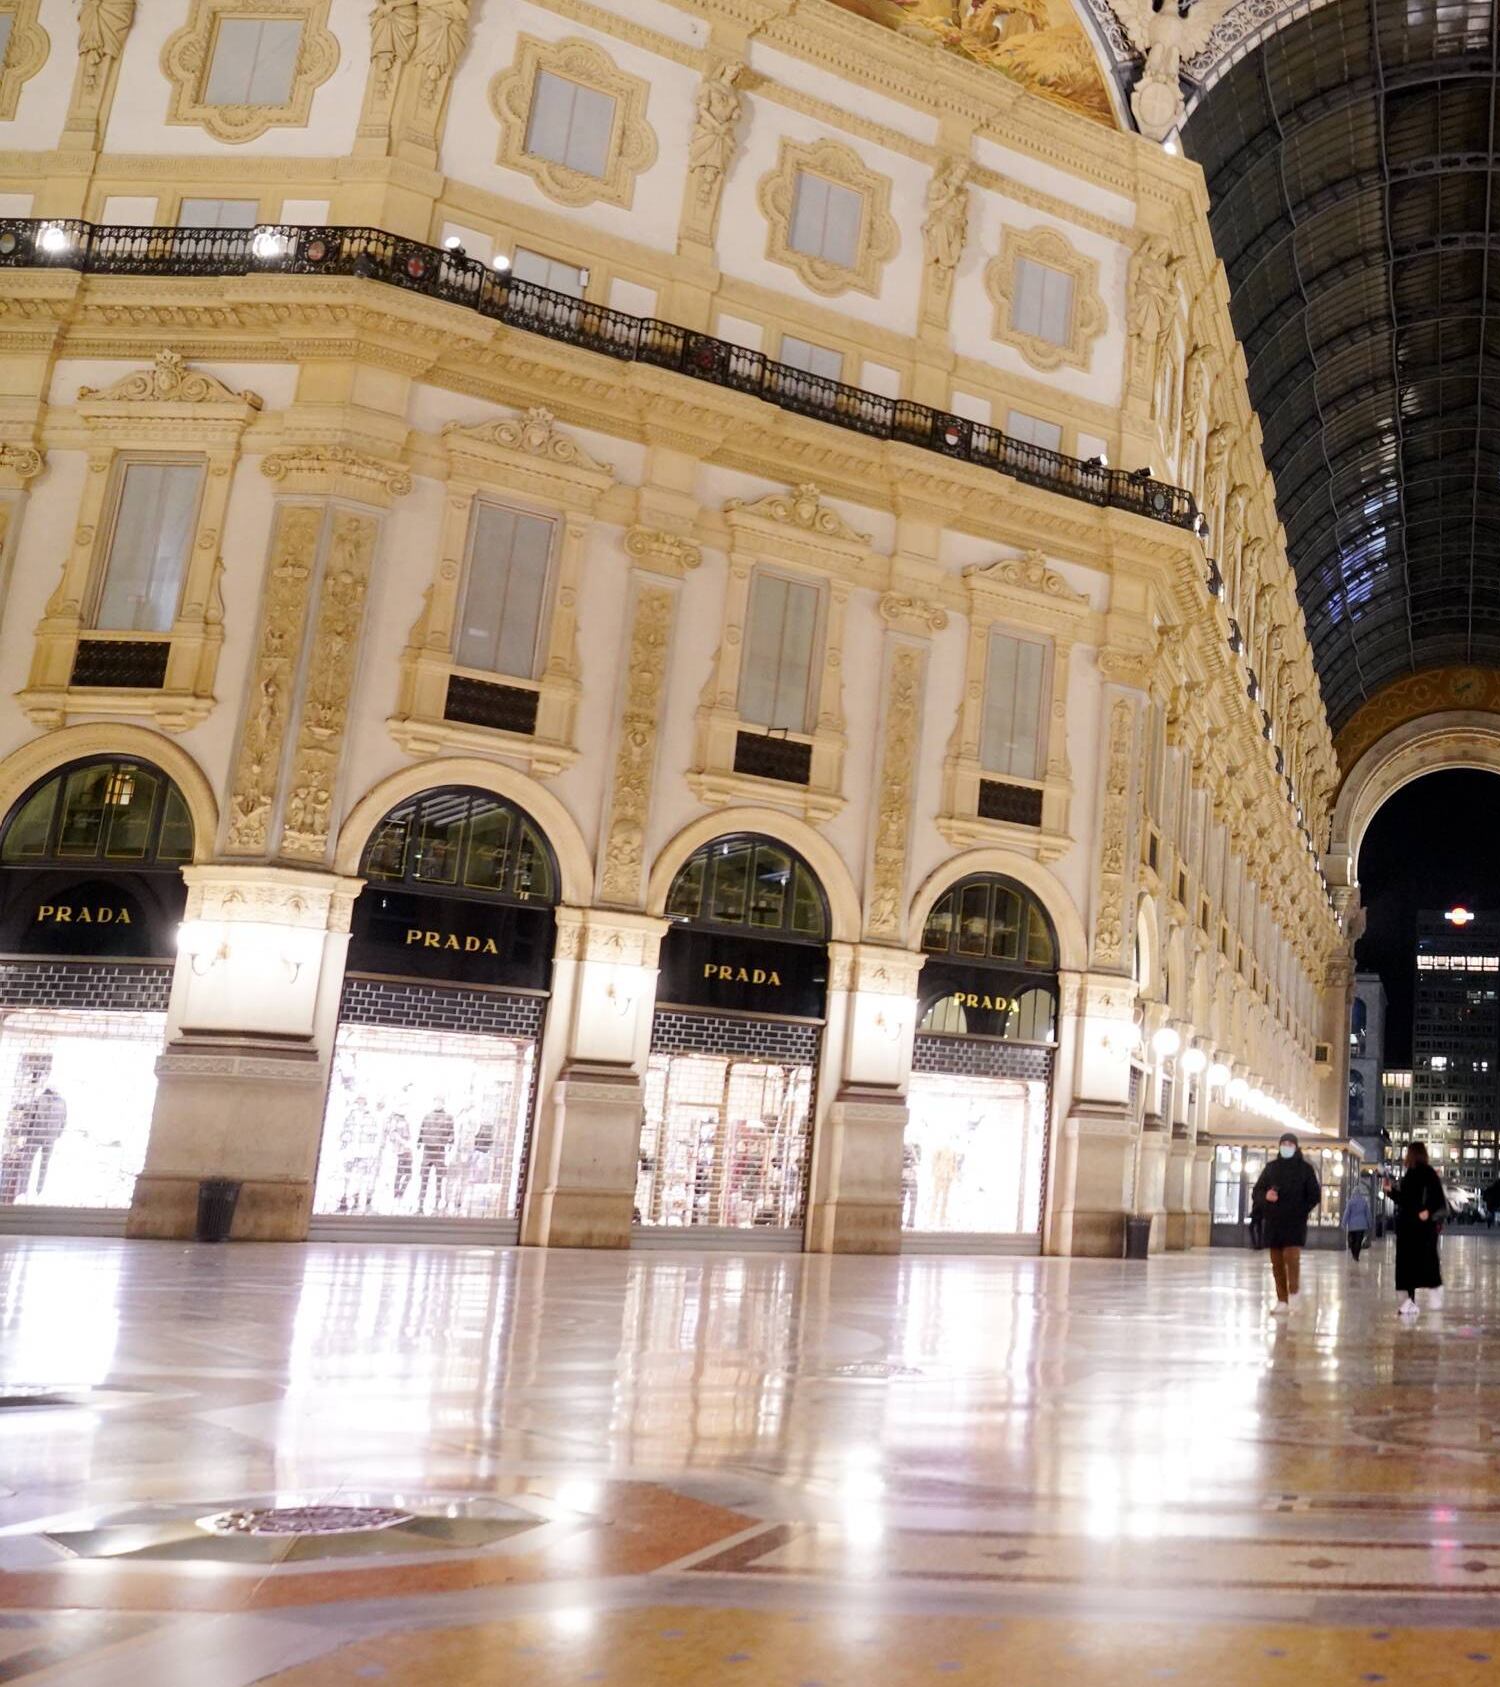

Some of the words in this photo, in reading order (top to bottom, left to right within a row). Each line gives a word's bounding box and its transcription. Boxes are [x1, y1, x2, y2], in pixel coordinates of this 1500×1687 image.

[38, 905, 131, 924] PRADA
[406, 929, 499, 954] PRADA
[704, 963, 781, 986] PRADA
[953, 992, 1020, 1013] PRADA
